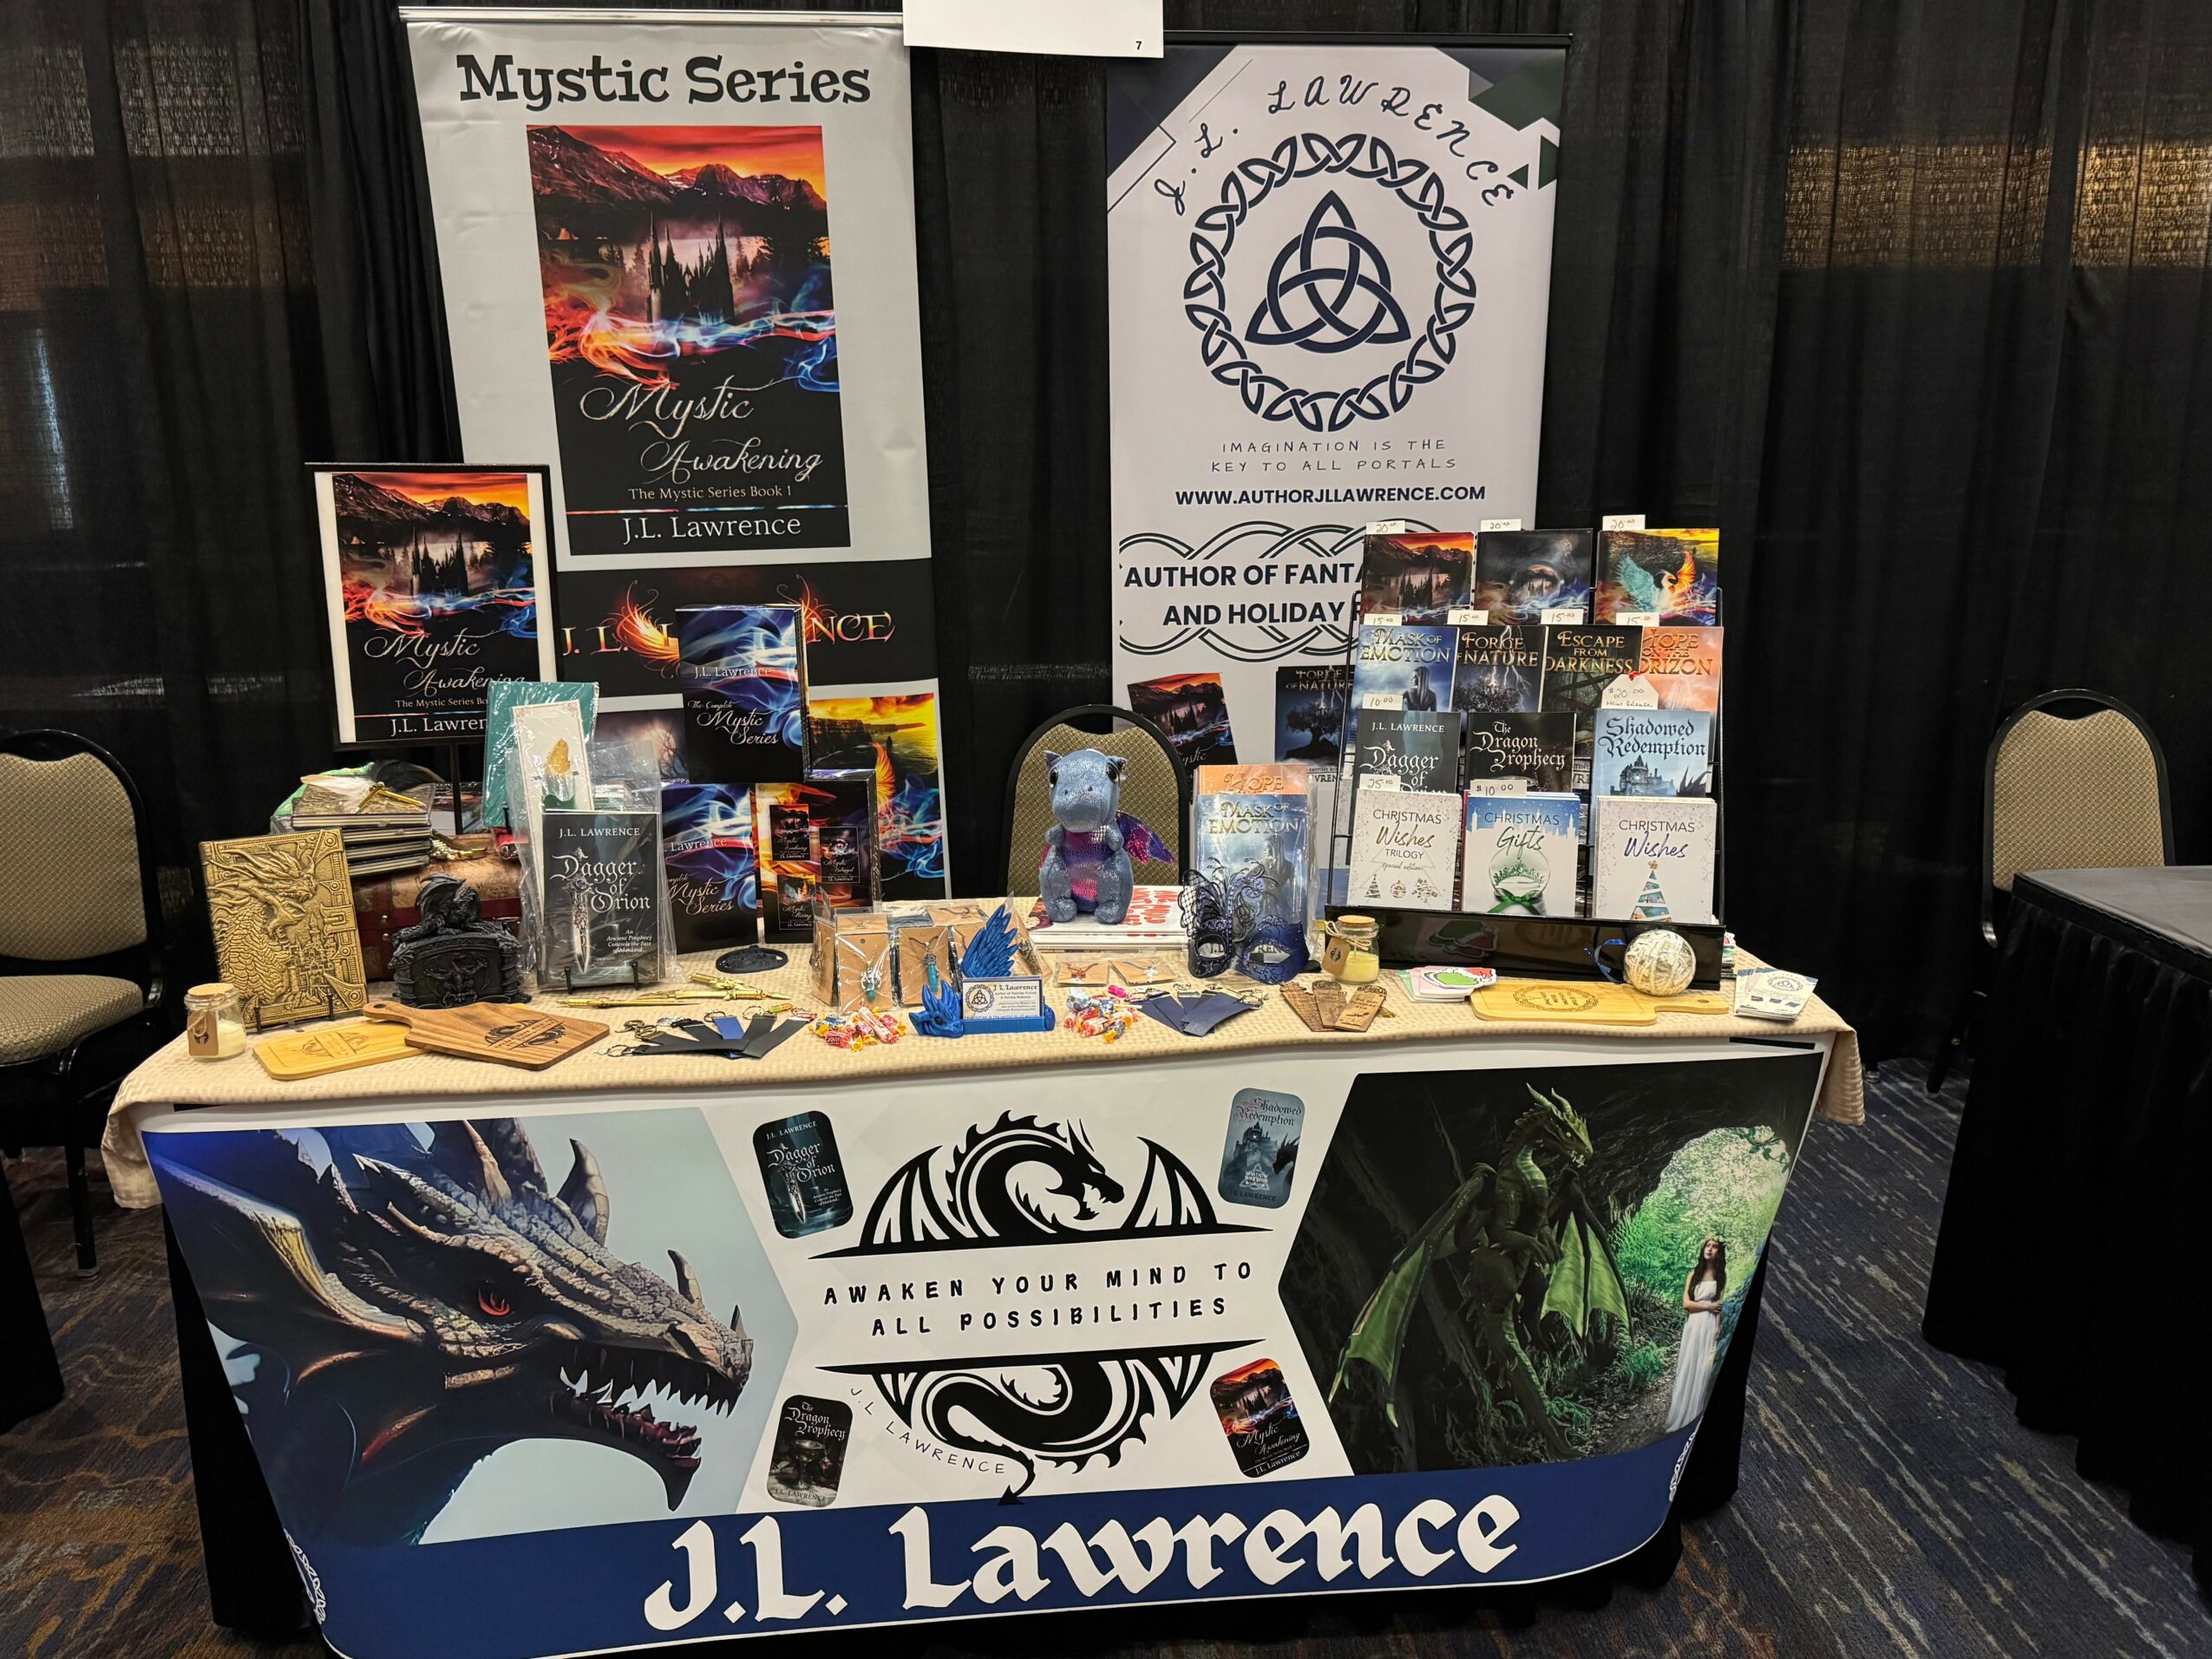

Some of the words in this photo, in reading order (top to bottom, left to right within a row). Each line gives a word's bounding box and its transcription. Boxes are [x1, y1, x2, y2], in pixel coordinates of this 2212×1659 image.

[1135, 41, 1142, 50] 7
[456, 54, 669, 111] Mystic
[685, 54, 871, 105] Series
[1267, 75, 1515, 207] LAWRENCE
[579, 376, 781, 441] Mystic
[1222, 441, 1359, 454] IMAGINATION
[1374, 441, 1392, 452] IS
[1408, 438, 1446, 450] THE
[641, 437, 823, 484] Awakening
[1212, 460, 1249, 473] KEY
[1262, 460, 1287, 472] TO
[1302, 460, 1342, 471] ALL
[1358, 458, 1456, 470] PORTALS
[629, 487, 657, 500] The
[660, 487, 704, 500] Mystic
[708, 486, 747, 499] Series
[750, 486, 782, 498] Book
[786, 487, 792, 497] 1
[1176, 486, 1486, 506] WWW.AUTHORJLLAWRENCE.COM
[623, 518, 662, 545] J.L.
[672, 515, 802, 539] Lawrence
[1124, 566, 1237, 587] AUTHOR
[1244, 565, 1279, 585] OF
[1162, 605, 1222, 626] AND
[1228, 601, 1345, 624] HOLIDAY
[1374, 627, 1423, 645] MASK
[1426, 635, 1443, 643] OF
[1462, 632, 1524, 650] FORCE
[1557, 630, 1625, 649] ESCAPE
[364, 628, 503, 669] Mystic
[1359, 645, 1450, 662] EMOTION
[1666, 649, 1691, 657] THE
[1464, 650, 1539, 667] NATURE
[1545, 656, 1634, 675] DARKNESS
[1639, 658, 1713, 676] ORIZON
[694, 666, 711, 679] J.L.
[715, 664, 771, 678] Lawrence
[403, 666, 525, 697] Awaken
[1299, 680, 1354, 691] NATURE
[416, 698, 445, 708] Mystic
[448, 697, 474, 706] Series
[390, 717, 417, 736] J.L.
[423, 715, 488, 732] Lawren
[697, 709, 768, 735] Mystic
[1372, 722, 1387, 731] J.L.
[1391, 723, 1444, 733] LAWRENCE
[1492, 721, 1511, 735] The
[1606, 715, 1694, 738] Shadowed
[730, 727, 779, 745] Series
[1470, 732, 1539, 753] Dragon
[1598, 736, 1706, 760] Redemption
[1359, 746, 1439, 775] Dagger
[1489, 749, 1566, 774] Prophecy
[1224, 774, 1284, 791] HOPE
[1411, 771, 1428, 787] of
[1221, 801, 1274, 818] MASK
[1274, 803, 1290, 812] OF
[1373, 810, 1442, 825] CHRISTMAS
[1484, 812, 1560, 826] CHRISTMAS
[559, 828, 577, 839] J.L.
[580, 827, 640, 837] LAWRENCE
[1208, 819, 1301, 834] EMOTION
[1619, 820, 1695, 833] CHRISTMAS
[671, 838, 727, 852] Lawrence
[1376, 824, 1436, 849] Wishes
[1496, 826, 1545, 859] Gifts
[1624, 833, 1689, 858] Wishes
[1385, 849, 1424, 859] TRILOGY
[550, 854, 638, 884] Dagger
[610, 878, 627, 895] of
[669, 878, 724, 905] Mystic
[591, 888, 651, 913] Orion
[686, 896, 735, 915] Series
[1235, 1105, 1295, 1127] Redemption
[1253, 1097, 1302, 1116] Shadowed
[779, 1120, 817, 1136] LAWRENCE
[766, 1143, 821, 1168] Dagger
[806, 1155, 817, 1168] of
[796, 1164, 835, 1182] Orion
[824, 1279, 963, 1305] AWAKEN
[993, 1273, 1078, 1296] YOUR
[1106, 1266, 1187, 1289] MIND
[1214, 1262, 1252, 1281] TO
[872, 1317, 931, 1336] ALL
[960, 1297, 1227, 1331] POSSIBILITIES
[784, 1407, 829, 1425] Dragon
[802, 1401, 814, 1413] The
[795, 1421, 846, 1441] Prophecy
[1236, 1422, 1280, 1447] Mystic
[886, 1421, 1005, 1474] LAWRENCE
[1255, 1433, 1300, 1455] Awakening
[1266, 1451, 1300, 1469] Lawrence
[788, 1491, 827, 1502] LAWRENCE
[645, 1517, 848, 1631] J.L.
[888, 1493, 1522, 1610] Lawrence
